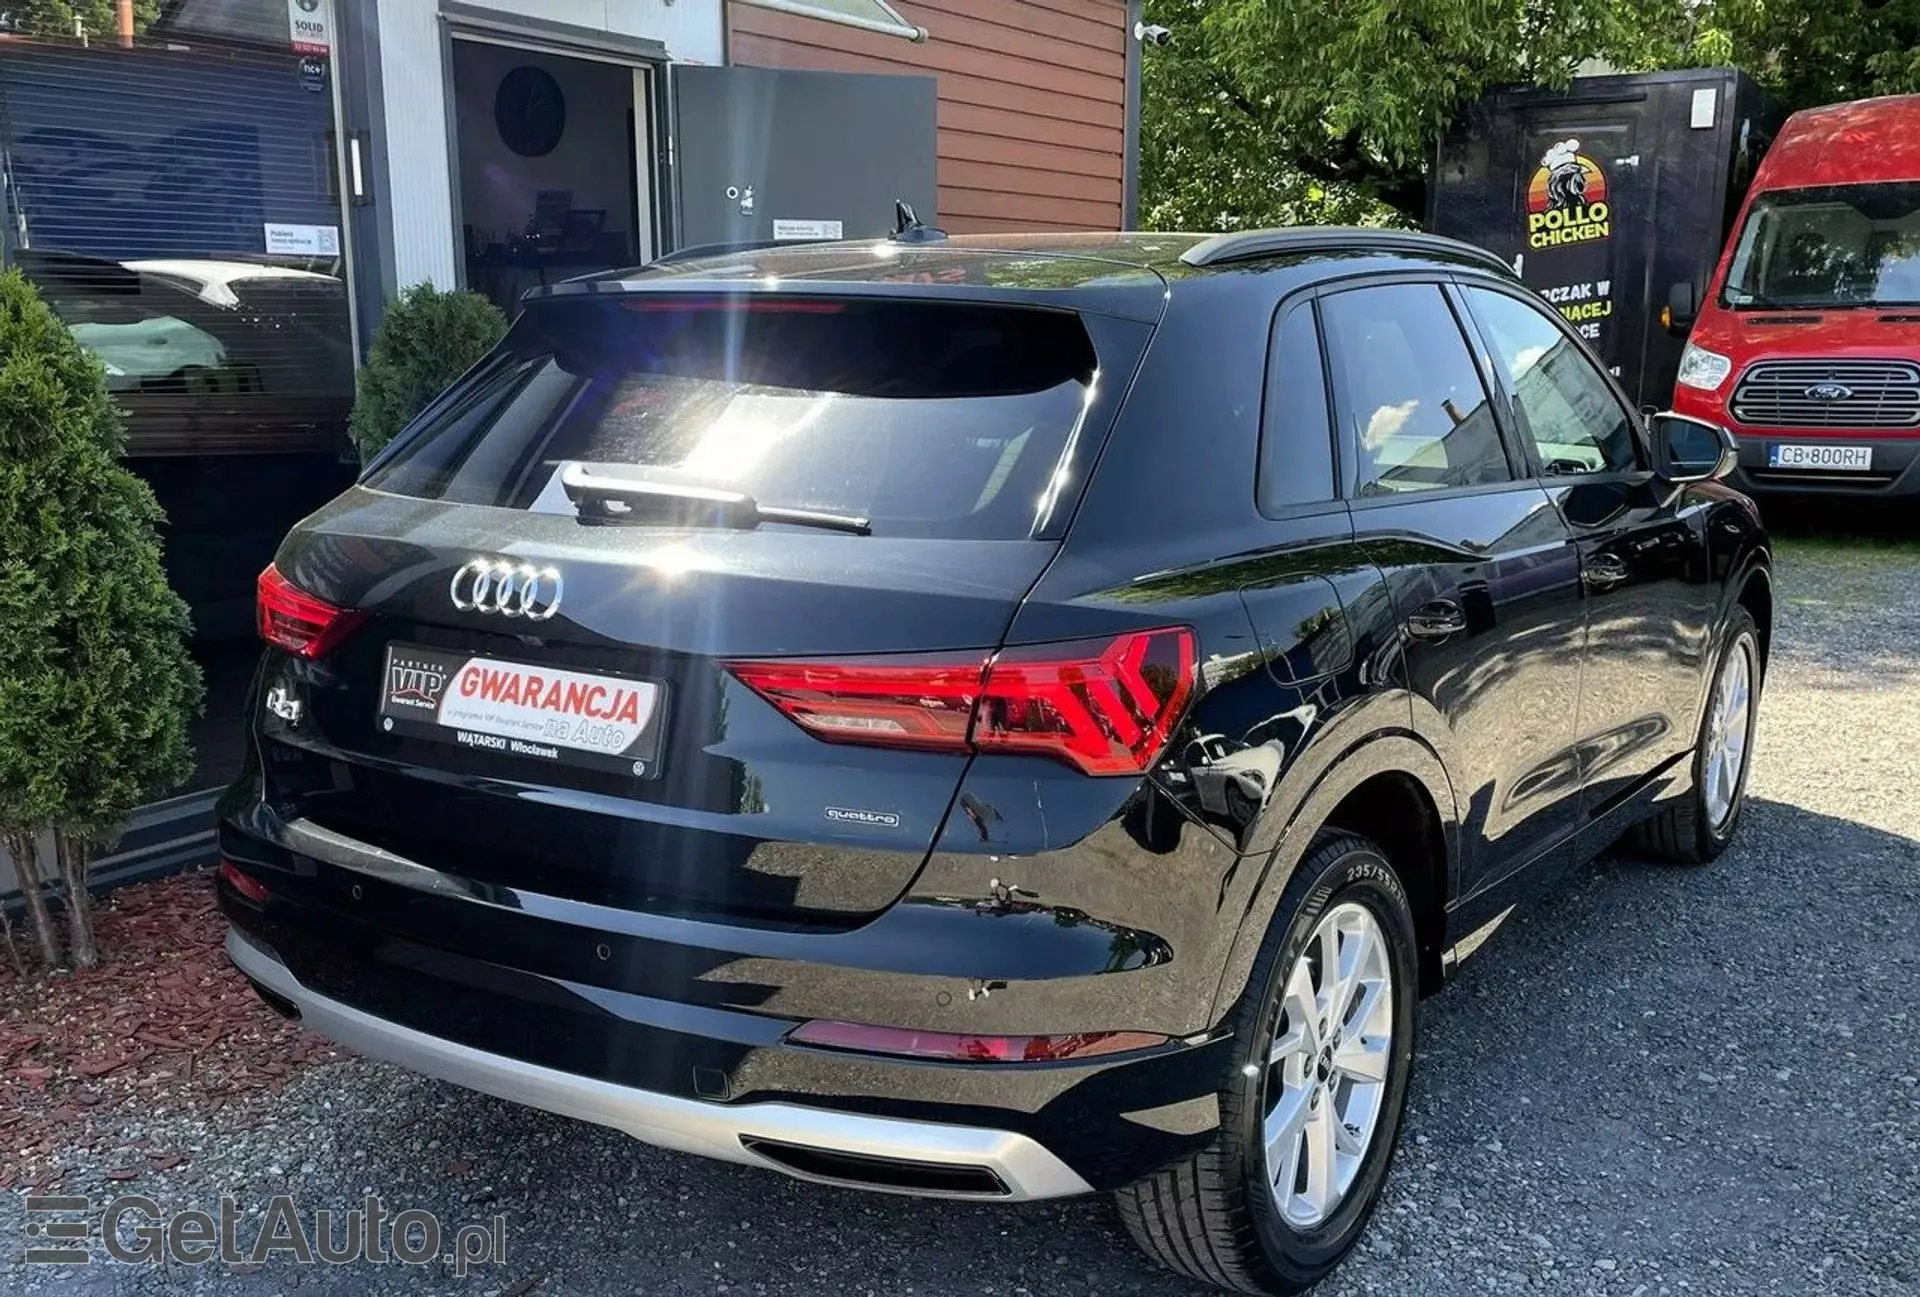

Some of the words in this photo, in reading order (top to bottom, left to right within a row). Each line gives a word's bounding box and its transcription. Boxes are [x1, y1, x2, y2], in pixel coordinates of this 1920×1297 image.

[295, 20, 324, 33] SOLID
[1529, 202, 1609, 232] POLLO
[1530, 222, 1610, 248] CHICKEN
[1597, 280, 1611, 297] W
[1559, 300, 1612, 322] IĄCEJ
[1575, 322, 1600, 339] CE
[1782, 447, 1804, 464] CB
[1810, 448, 1868, 465] 800RH
[392, 658, 444, 672] PARTNER
[391, 666, 443, 698] VIP
[460, 667, 639, 724] GWARANCJA
[457, 730, 506, 750] WĄTARSKI
[544, 718, 570, 741] na
[572, 718, 626, 750] Auto
[827, 809, 895, 824] quattro
